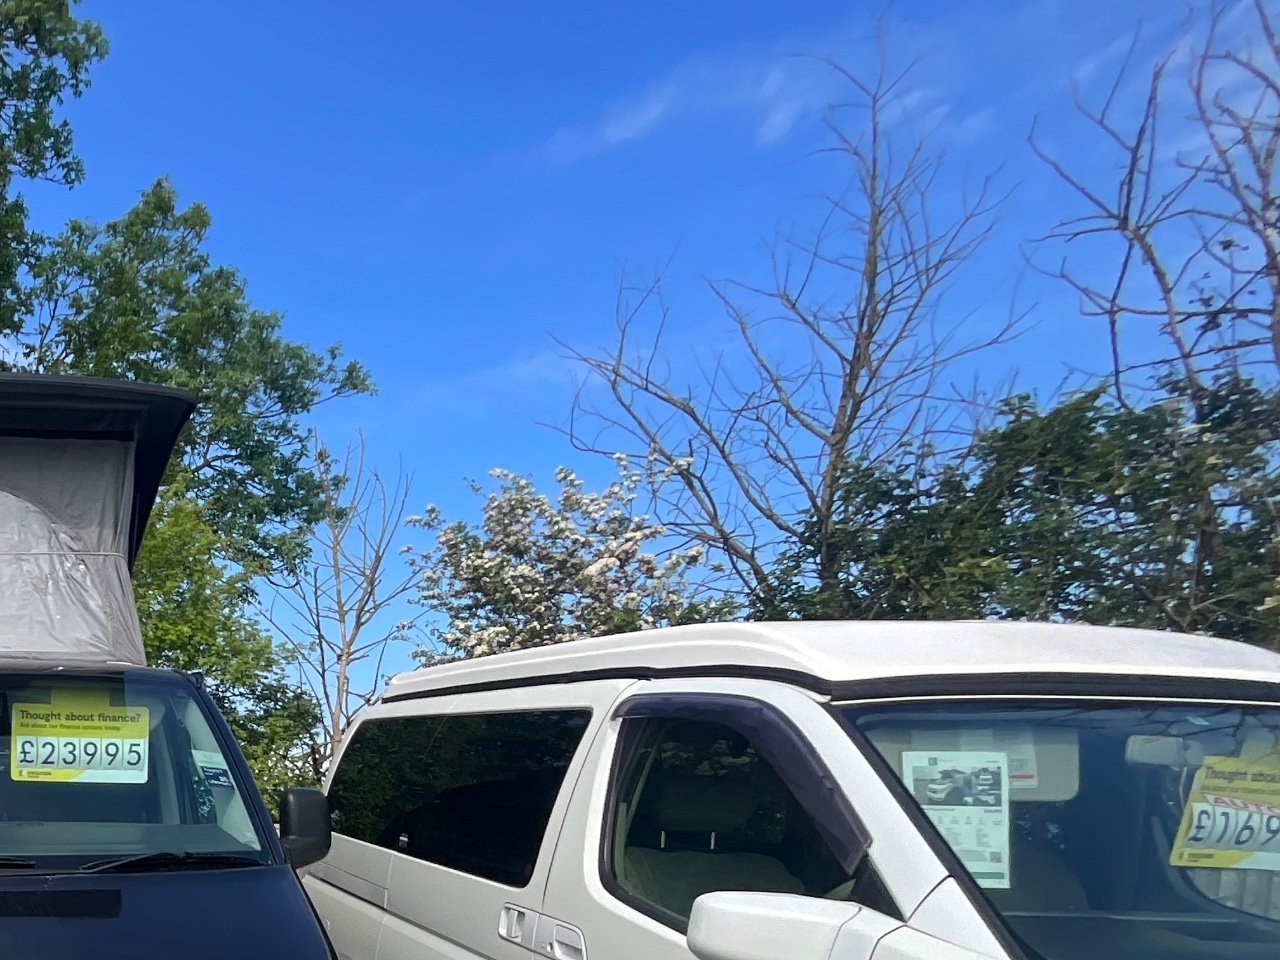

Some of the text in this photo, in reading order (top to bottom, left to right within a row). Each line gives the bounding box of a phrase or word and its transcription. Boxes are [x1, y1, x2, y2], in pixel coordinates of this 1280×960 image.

[19, 710, 142, 723] Thought about finance?
[19, 740, 142, 766] £23995
[1187, 809, 1280, 847] £169
